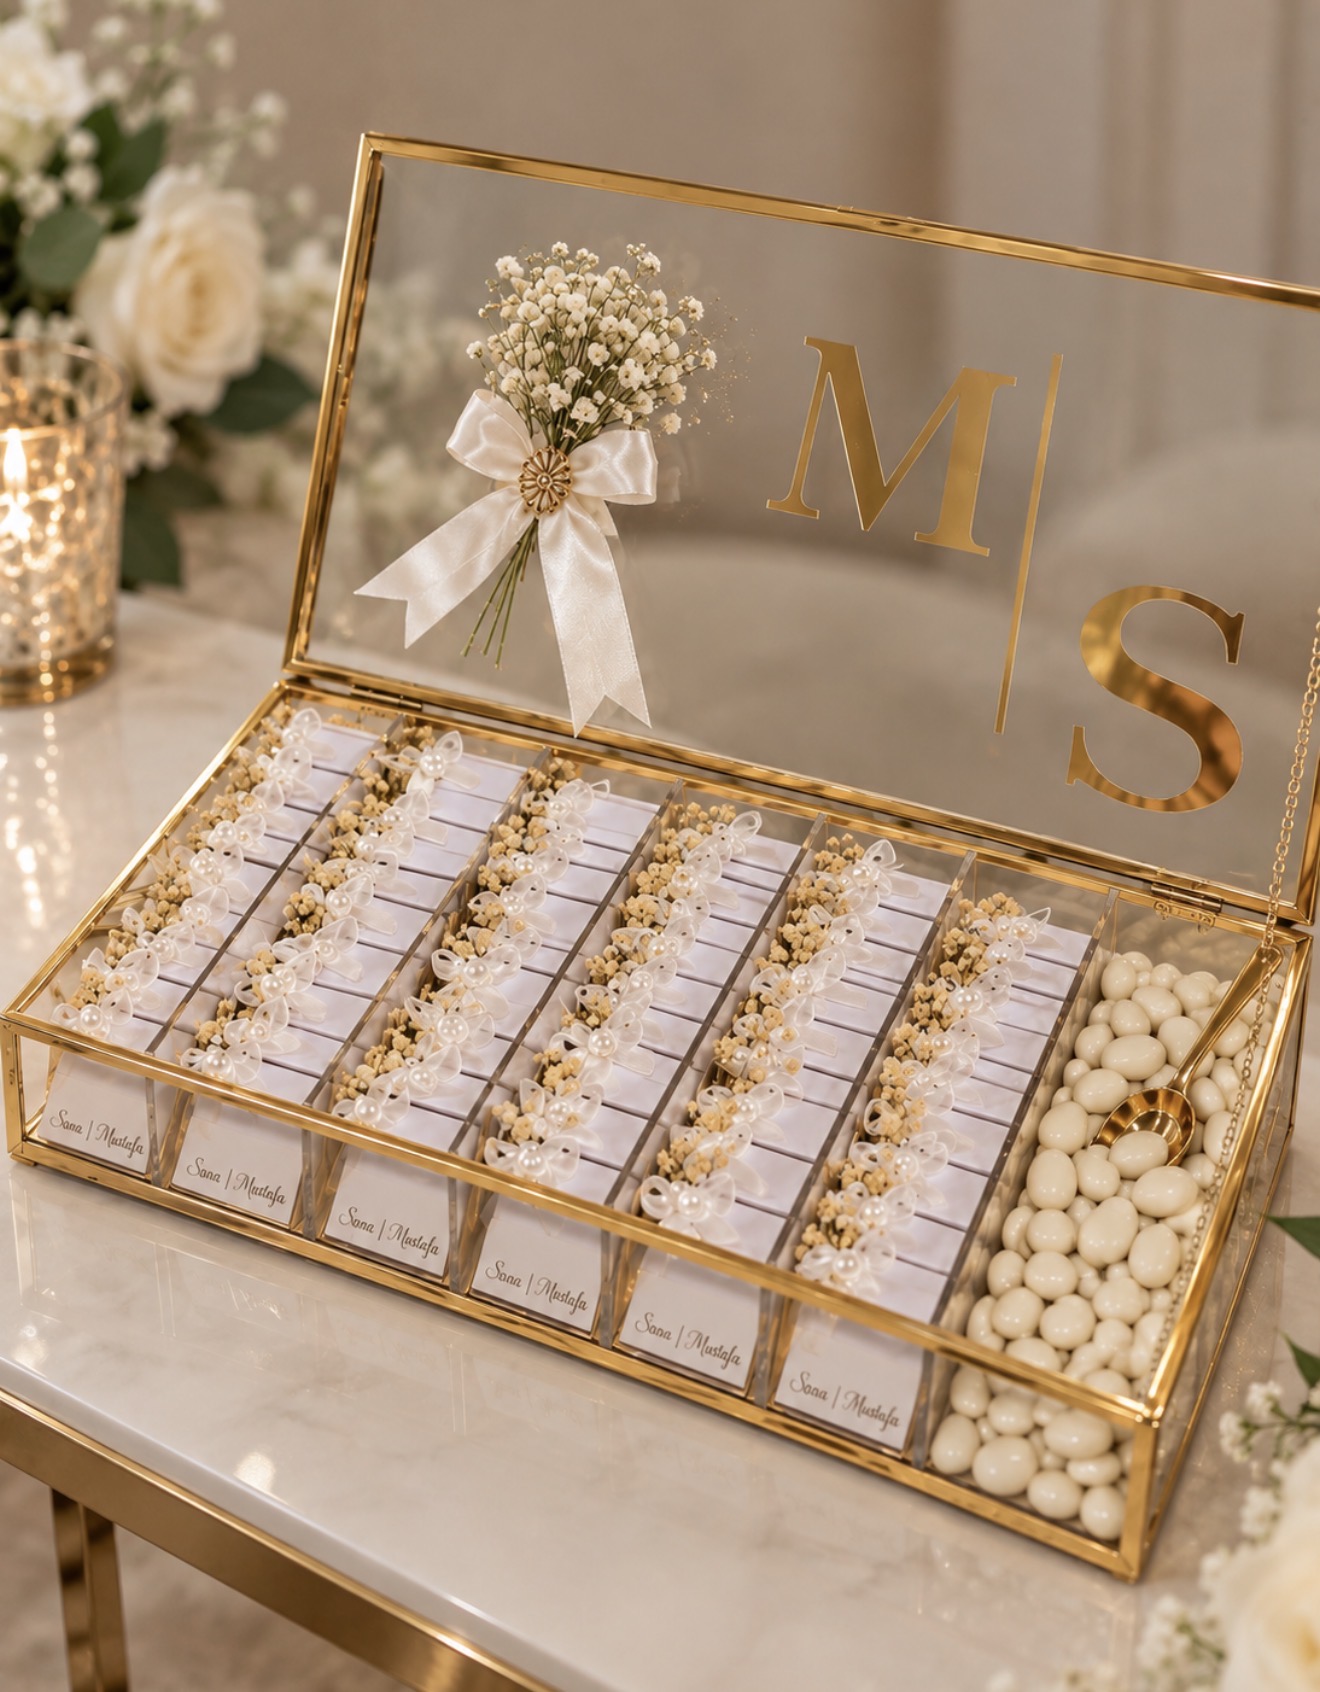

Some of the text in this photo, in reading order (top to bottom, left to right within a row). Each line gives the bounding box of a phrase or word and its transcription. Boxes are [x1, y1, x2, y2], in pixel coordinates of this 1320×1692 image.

[766, 336, 1245, 813] M S
[386, 1222, 440, 1260] Mustafa
[534, 1277, 589, 1315] Mustafa
[685, 1329, 742, 1370] Mustafa
[841, 1390, 901, 1431] Mustafa
